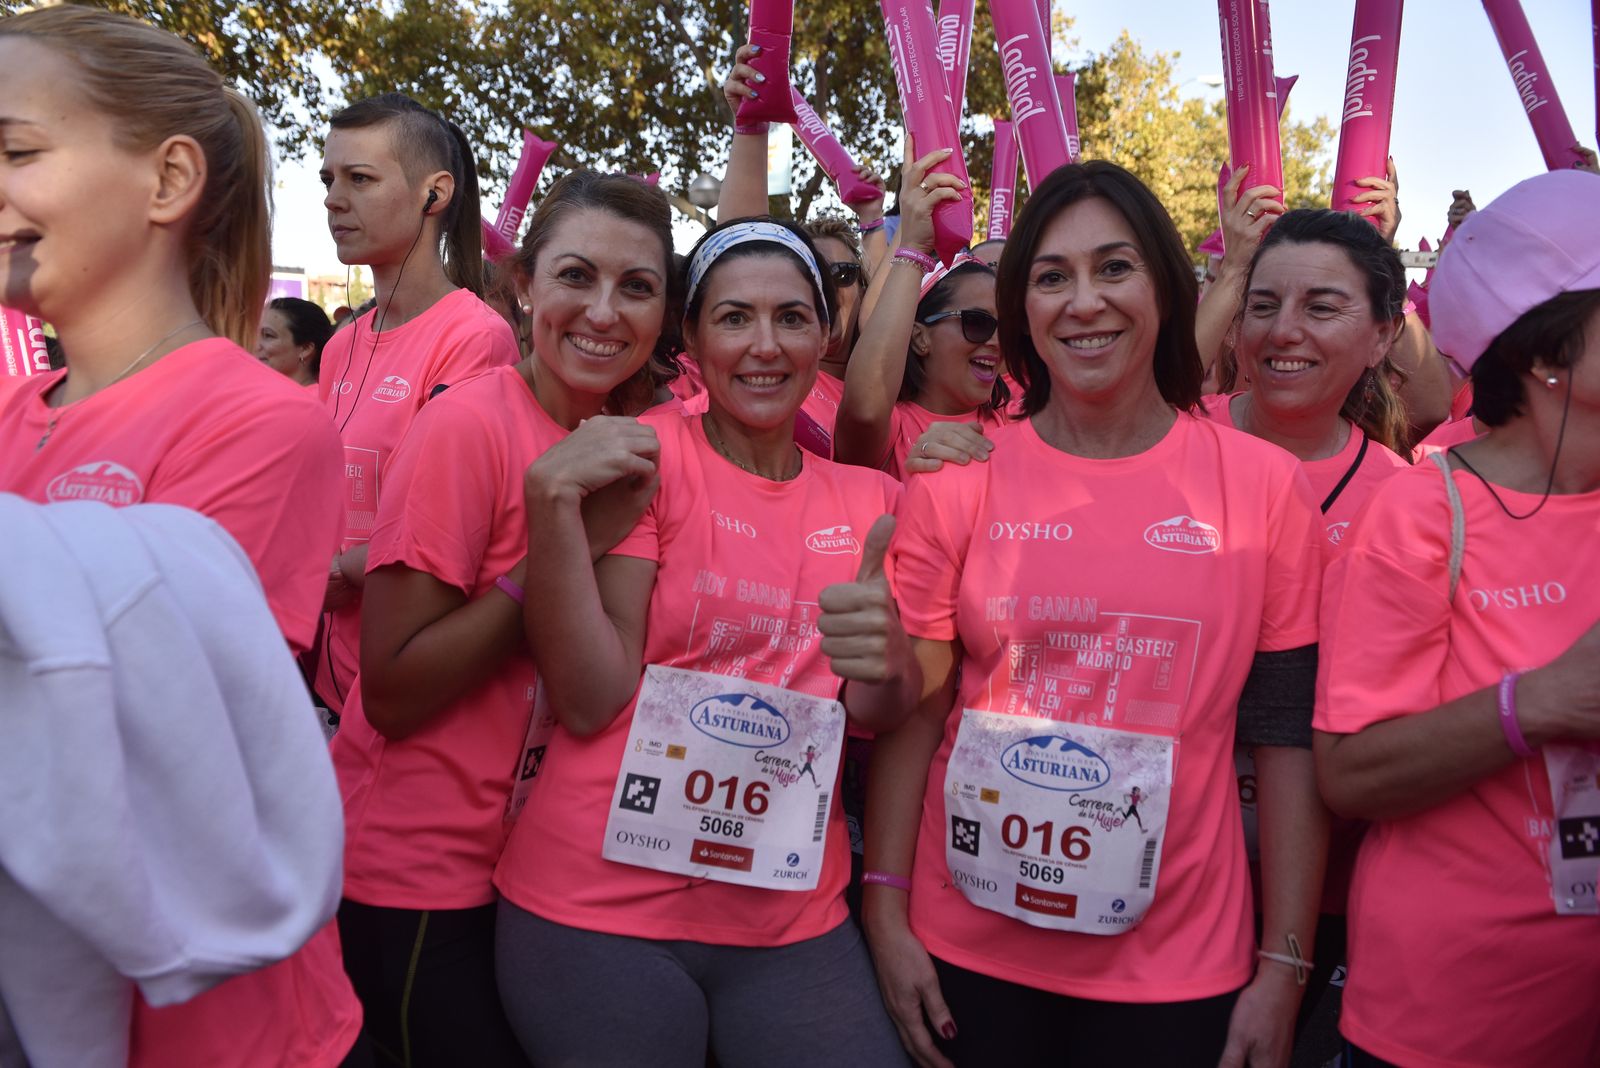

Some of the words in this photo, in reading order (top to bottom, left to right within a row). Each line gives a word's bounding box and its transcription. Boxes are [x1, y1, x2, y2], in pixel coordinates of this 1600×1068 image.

[900, 6, 911, 31] SOLAR
[914, 77, 925, 103] TRIPLE
[1001, 33, 1046, 125] Ladival
[1343, 34, 1382, 124] Ladival
[1507, 49, 1548, 114] Ladival
[990, 188, 1011, 240] Ladival
[989, 521, 1073, 541] OYSHO
[1151, 528, 1217, 547] ASTURIANA
[691, 569, 728, 598] HOY
[736, 578, 792, 610] GANAN
[1469, 581, 1567, 612] OYSHO
[985, 596, 1019, 622] HOY
[1028, 596, 1099, 622] GANAN
[1076, 651, 1133, 671] MADRID
[696, 706, 782, 740] ASTURIANA
[754, 749, 792, 768] Carrera
[1007, 749, 1101, 783] ASTURIANA
[772, 767, 801, 788] Mujer
[684, 769, 771, 816] 016
[1068, 793, 1114, 813] Carrera
[699, 815, 744, 838] 5068
[1093, 811, 1126, 832] Mujer
[616, 830, 671, 852] OYSHO
[1001, 813, 1092, 861] 016
[709, 850, 746, 863] Santander
[772, 869, 808, 880] ZURICH
[953, 870, 998, 893] OYSHO
[1019, 860, 1065, 885] 5069
[1030, 895, 1068, 911] Santander
[1098, 915, 1134, 925] ZURICH
